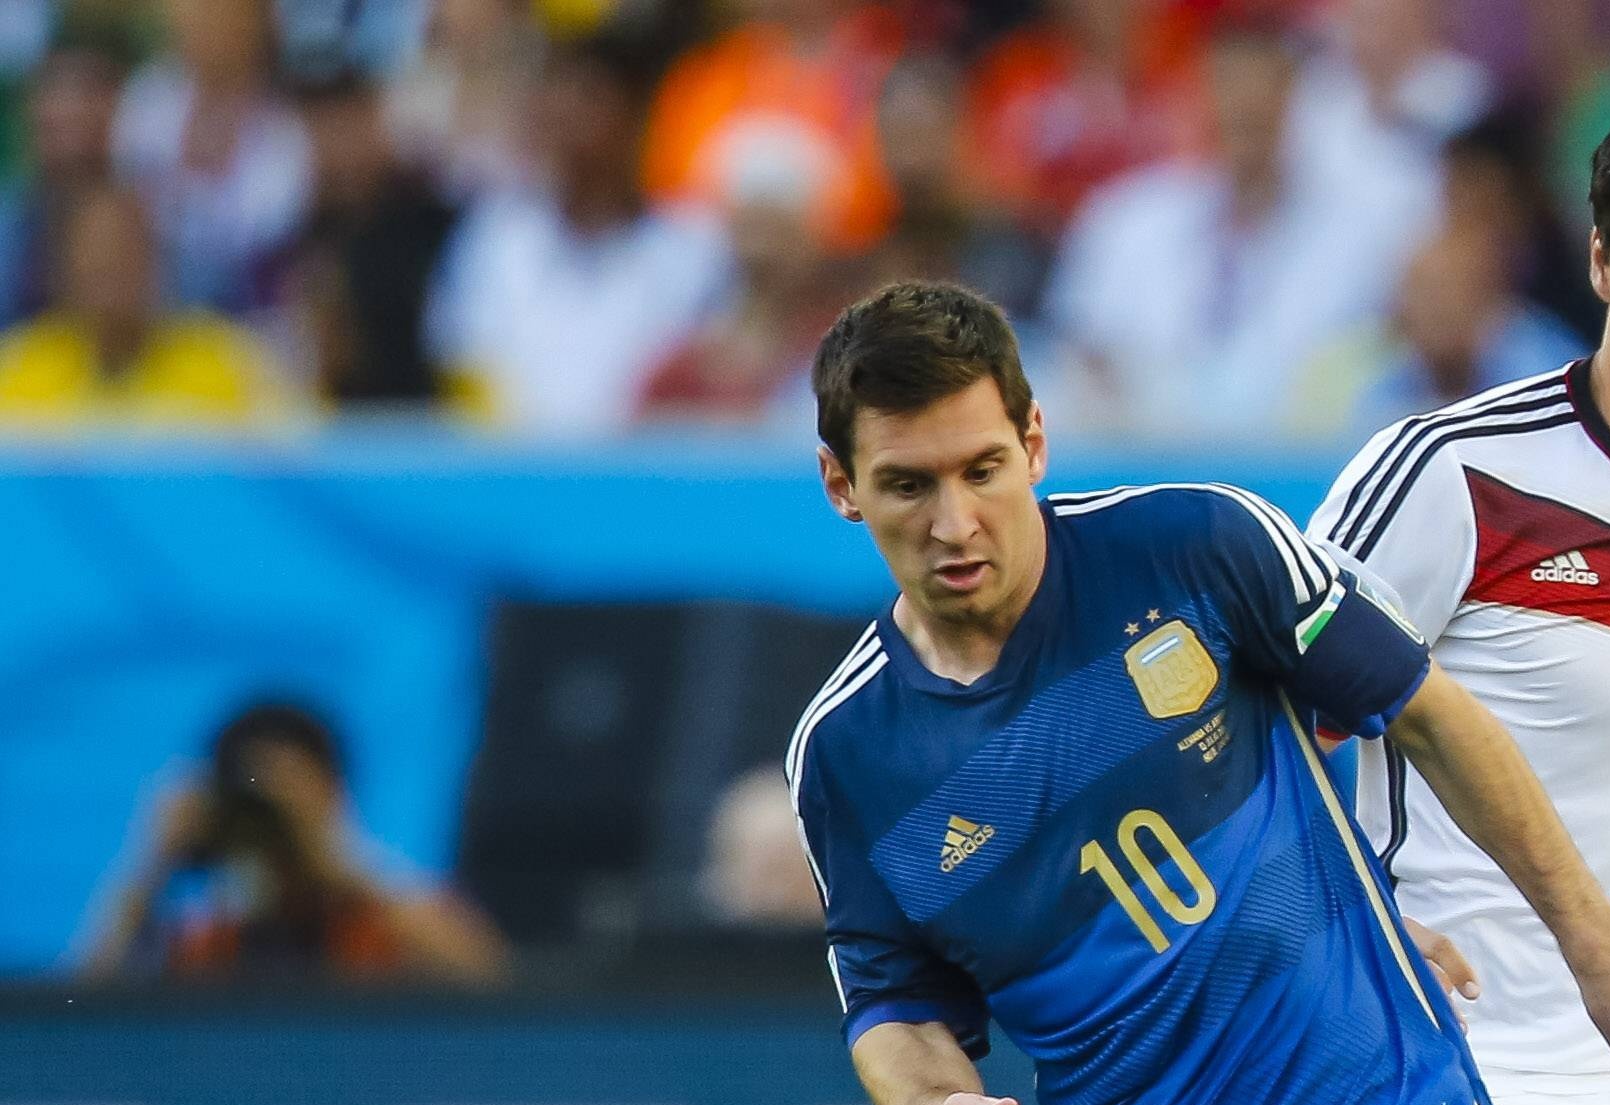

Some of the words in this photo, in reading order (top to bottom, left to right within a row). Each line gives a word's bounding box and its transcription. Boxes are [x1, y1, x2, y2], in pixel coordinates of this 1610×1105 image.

[1530, 567, 1600, 586] adidas
[938, 824, 997, 873] adidas
[1079, 808, 1217, 954] 10
